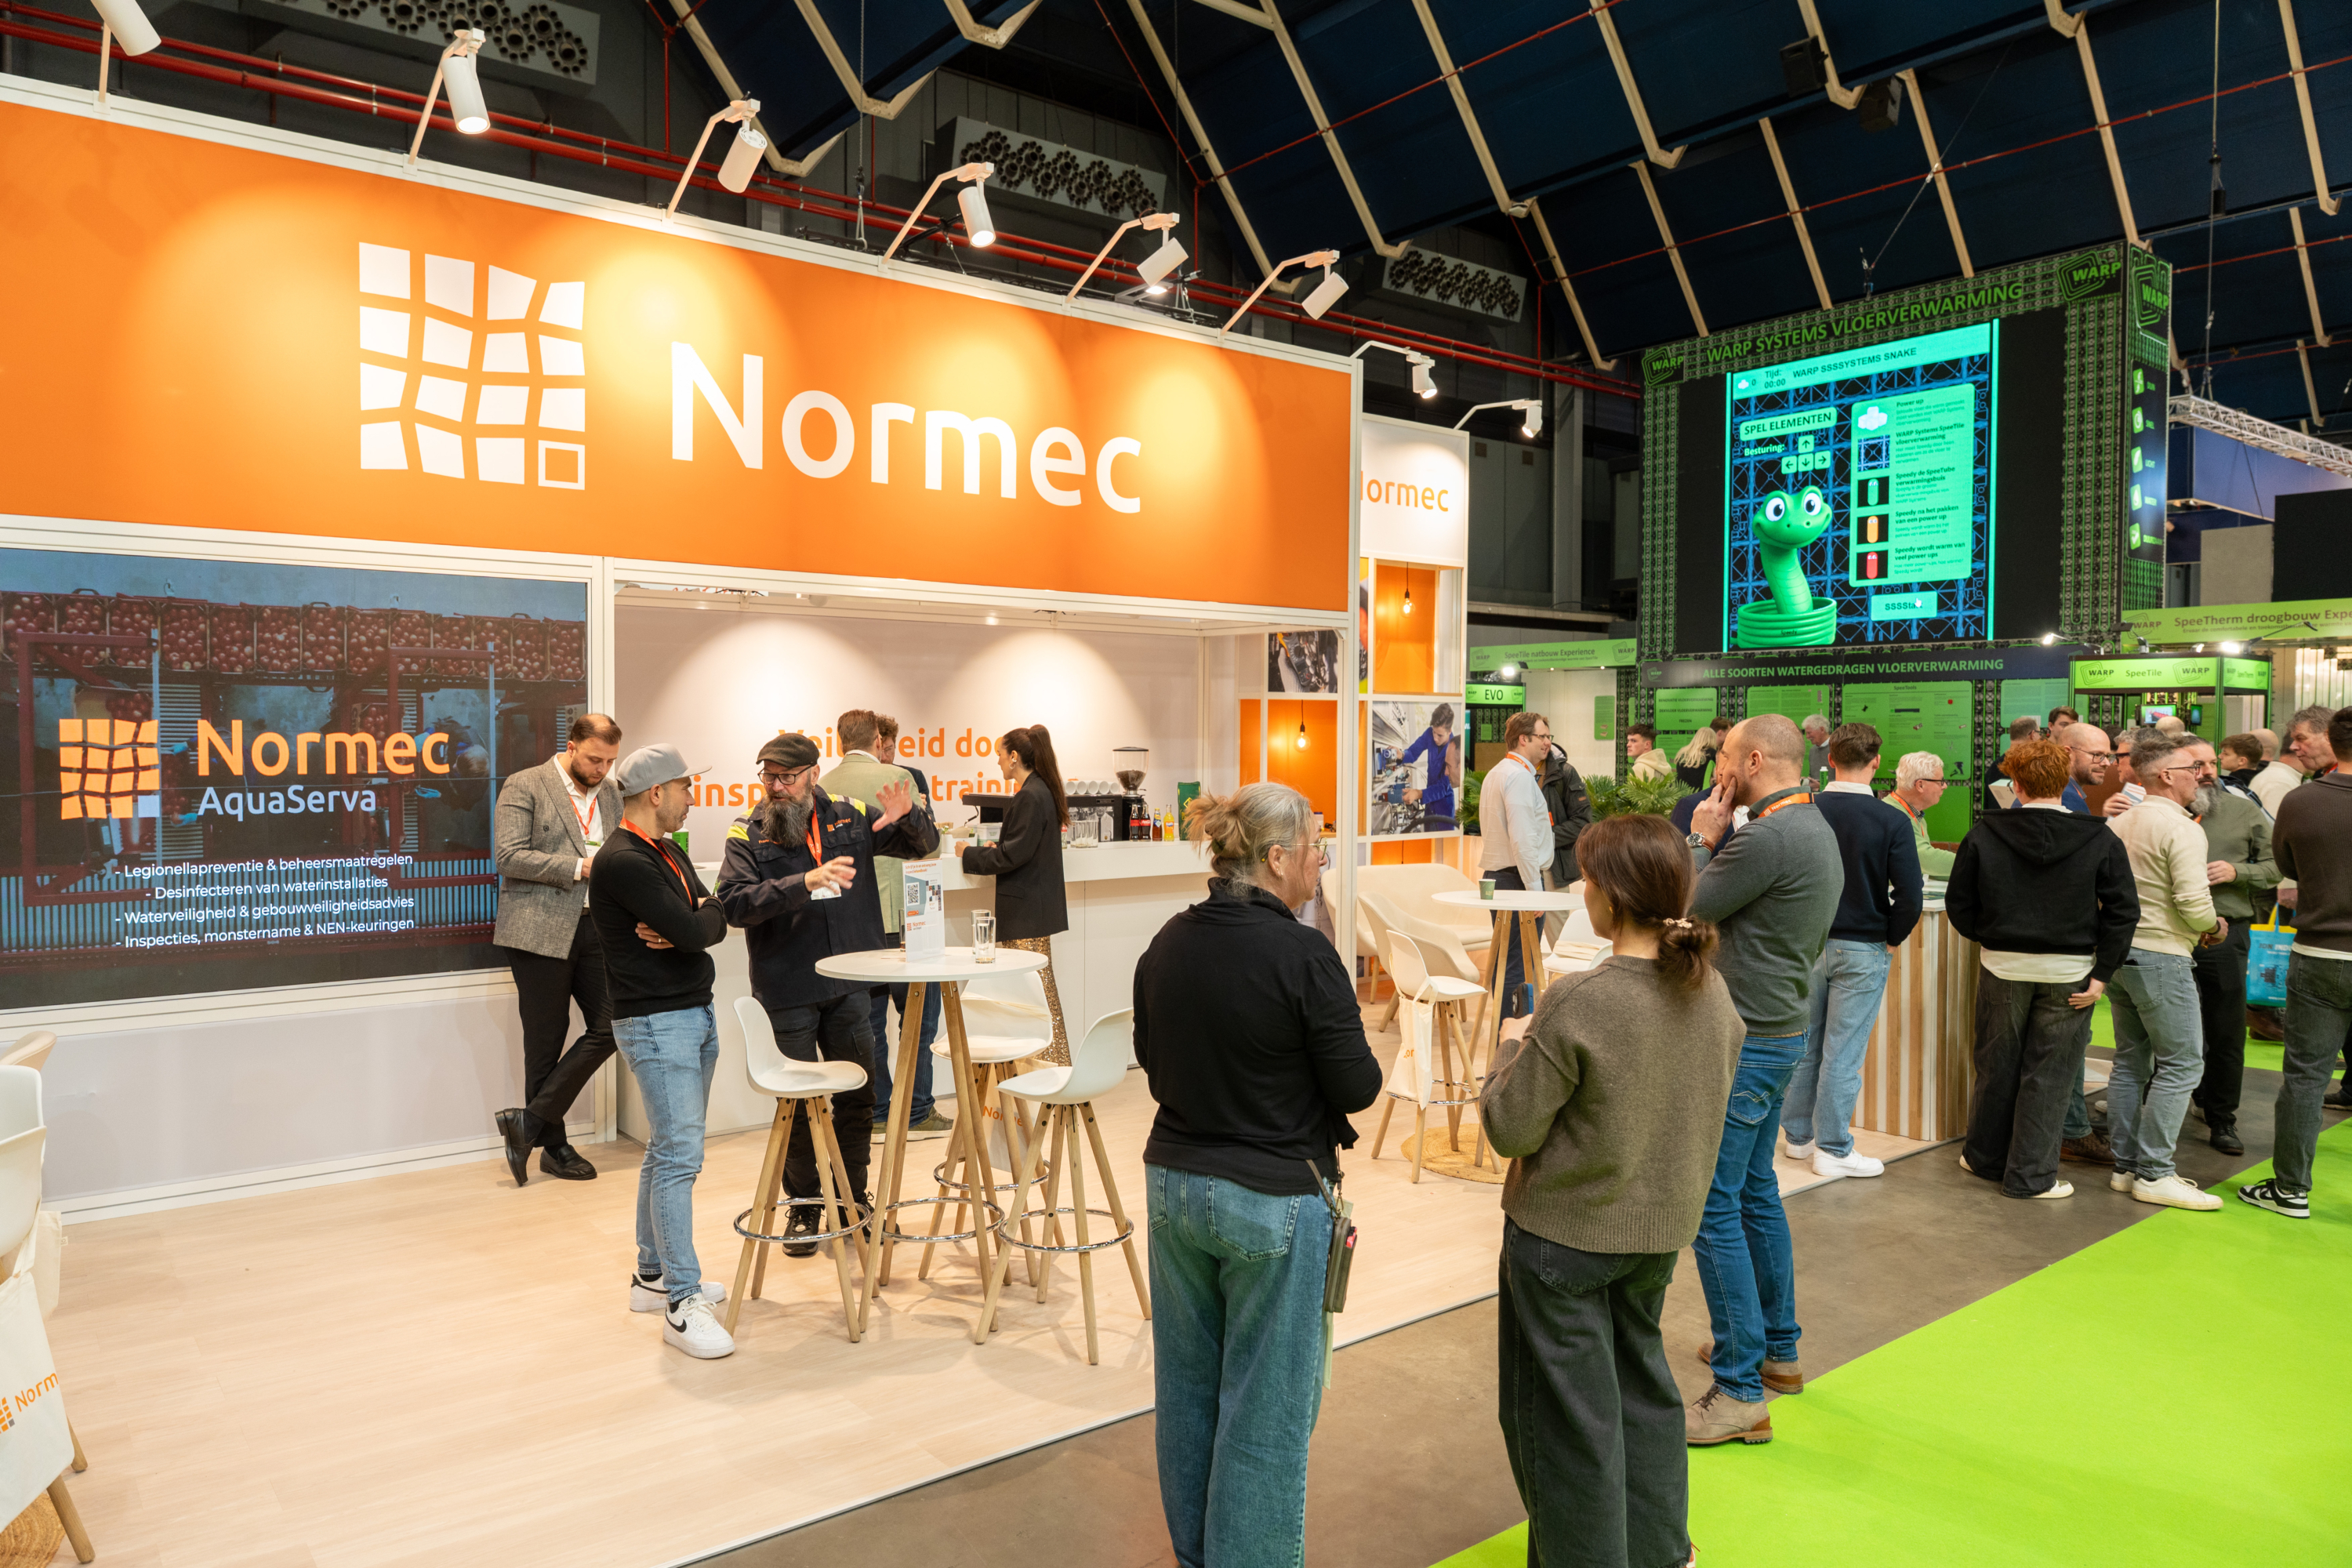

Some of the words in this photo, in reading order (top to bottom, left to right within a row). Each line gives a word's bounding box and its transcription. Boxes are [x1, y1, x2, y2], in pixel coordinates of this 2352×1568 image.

[2072, 262, 2122, 281] WARP
[2142, 283, 2169, 310] WARP
[1706, 341, 1752, 363] WARP
[1756, 324, 1828, 353] SYSTEMS
[1831, 282, 2024, 336] VLOERVERWARMING
[1651, 355, 1684, 372] WARP
[1793, 367, 1819, 378] WARP
[1820, 354, 1882, 373] SSSSYSTEMS
[1883, 347, 1918, 361] SNAKE
[1765, 368, 1782, 379] Tijd:
[1764, 378, 1786, 389] 00:00
[671, 340, 1142, 514] Normec
[1744, 423, 1767, 435] SPEL
[1769, 412, 1832, 431] ELEMENTEN
[1915, 427, 1938, 436] Systems
[1939, 423, 1965, 432] SpeeTile
[1896, 434, 1946, 445] vloerverwarming
[1744, 443, 1785, 456] Besturing:
[1896, 471, 1917, 480] Speedy
[1926, 466, 1955, 476] SpeeTube
[1896, 475, 1946, 486] verwarmingsbuis
[1360, 470, 1449, 512] ormec
[1937, 505, 1959, 514] pakken
[1885, 602, 1922, 611] SSSSta
[2133, 620, 2161, 629] WARP
[2174, 615, 2243, 628] SpeeTherm
[2247, 611, 2321, 626] droogbouw
[1504, 651, 1530, 660] SpeeTile
[1531, 649, 1559, 658] natbouw
[1560, 648, 1595, 657] Experience
[1702, 669, 1725, 679] ALLE
[1727, 666, 1775, 678] SOORTEN
[1777, 663, 1875, 677] WATERGEDRAGEN
[1878, 659, 2004, 674] VLOERVERWARMING
[2125, 669, 2162, 677] SpeeTile
[1485, 689, 1504, 701] EVO
[198, 719, 450, 776] Normec
[198, 784, 376, 822] AquaServa
[1771, 799, 1792, 811] Normec
[125, 859, 263, 880] Legionellapreventie
[267, 858, 276, 871] &
[279, 854, 413, 871] beheersmaatregelen
[155, 883, 252, 899] Desinfecteren
[256, 883, 280, 894] van
[283, 877, 388, 893] waterinstallaties
[125, 905, 236, 924] Waterveiligheid
[239, 904, 249, 916] &
[252, 896, 415, 918] gebouwveiligheidsadvies
[125, 932, 201, 949] Inspecties,
[204, 925, 301, 943] monstername
[304, 924, 313, 936] &
[317, 918, 414, 935] NEN-keuringen
[982, 1105, 1023, 1127] Nore
